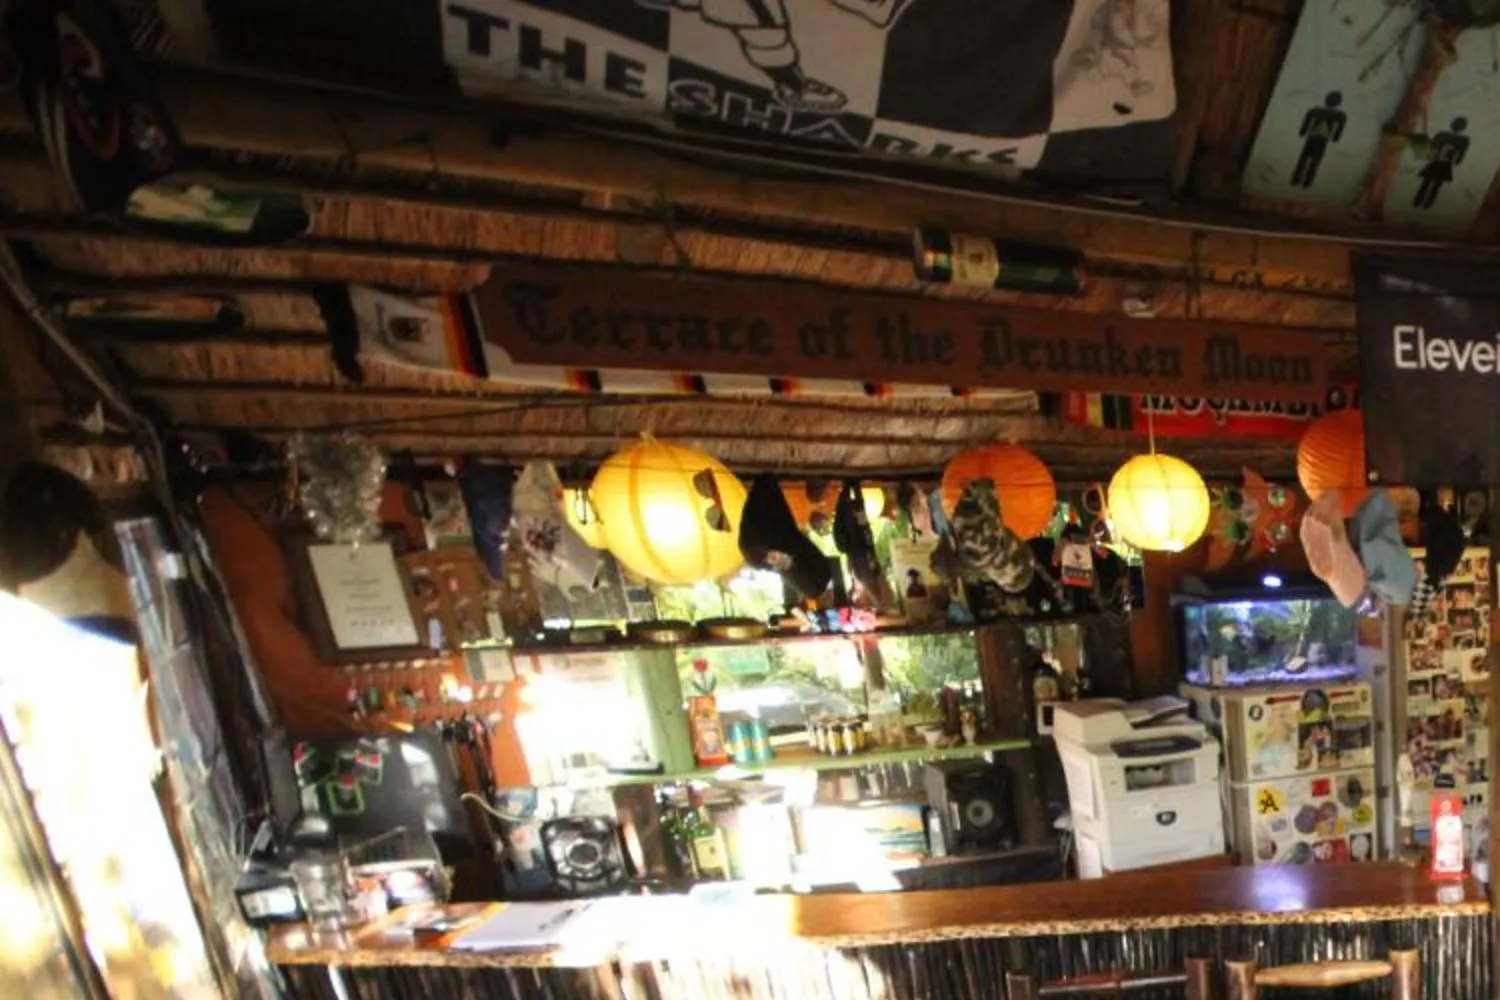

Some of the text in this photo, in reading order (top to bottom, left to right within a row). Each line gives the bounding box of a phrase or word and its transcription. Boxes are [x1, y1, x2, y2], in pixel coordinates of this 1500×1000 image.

[445, 4, 648, 98] THE
[505, 280, 1313, 385] Terrace of the Drunken Moon
